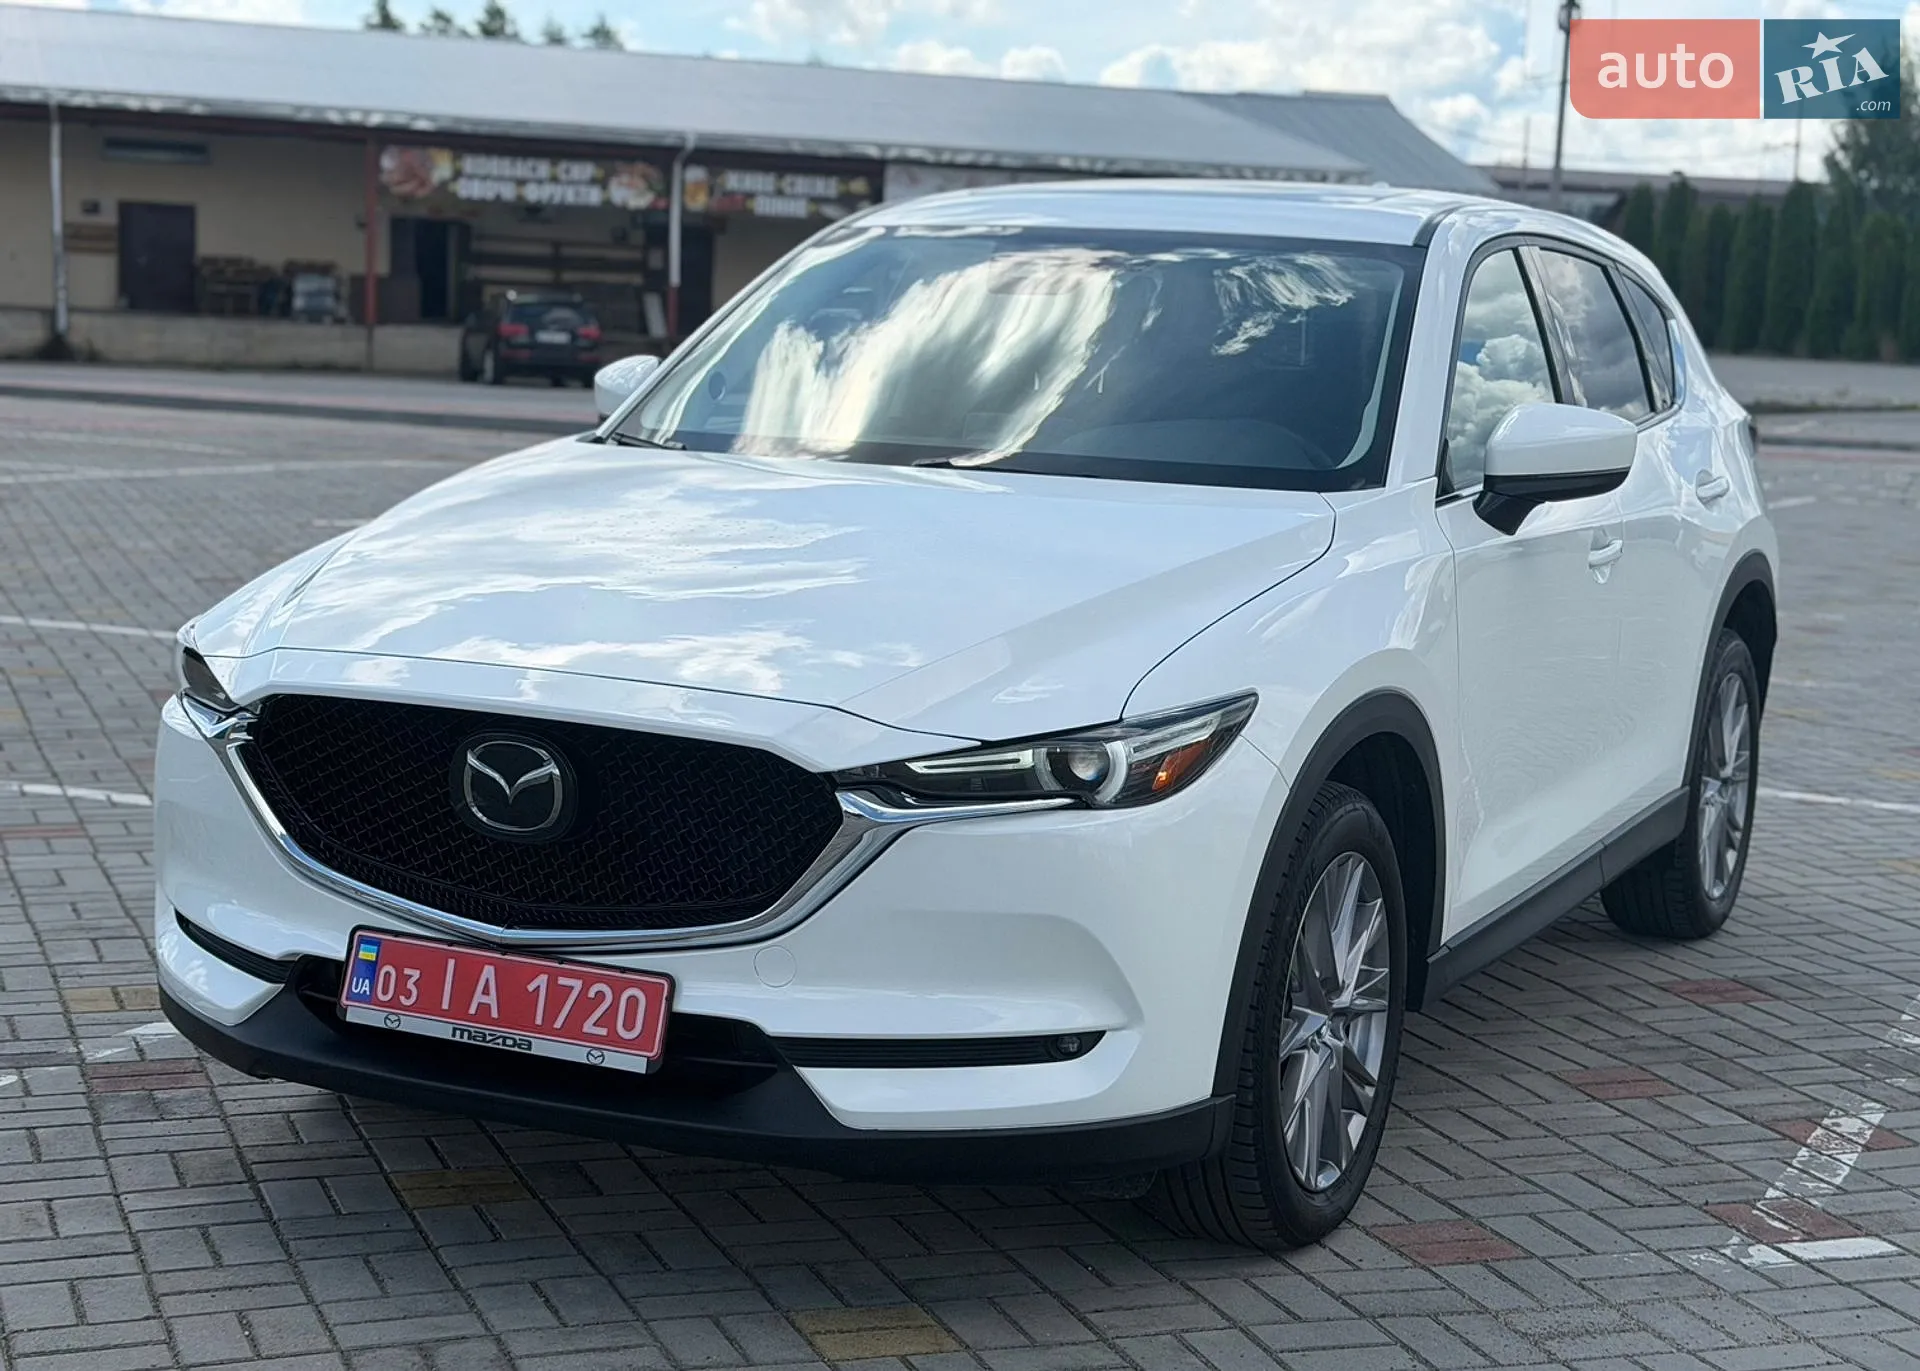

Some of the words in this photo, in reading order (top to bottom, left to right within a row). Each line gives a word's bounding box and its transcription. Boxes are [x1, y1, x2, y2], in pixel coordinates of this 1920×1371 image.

[351, 976, 370, 996] UA
[375, 965, 422, 1006] 03
[527, 973, 647, 1040] 1720
[451, 1025, 532, 1051] mazda
